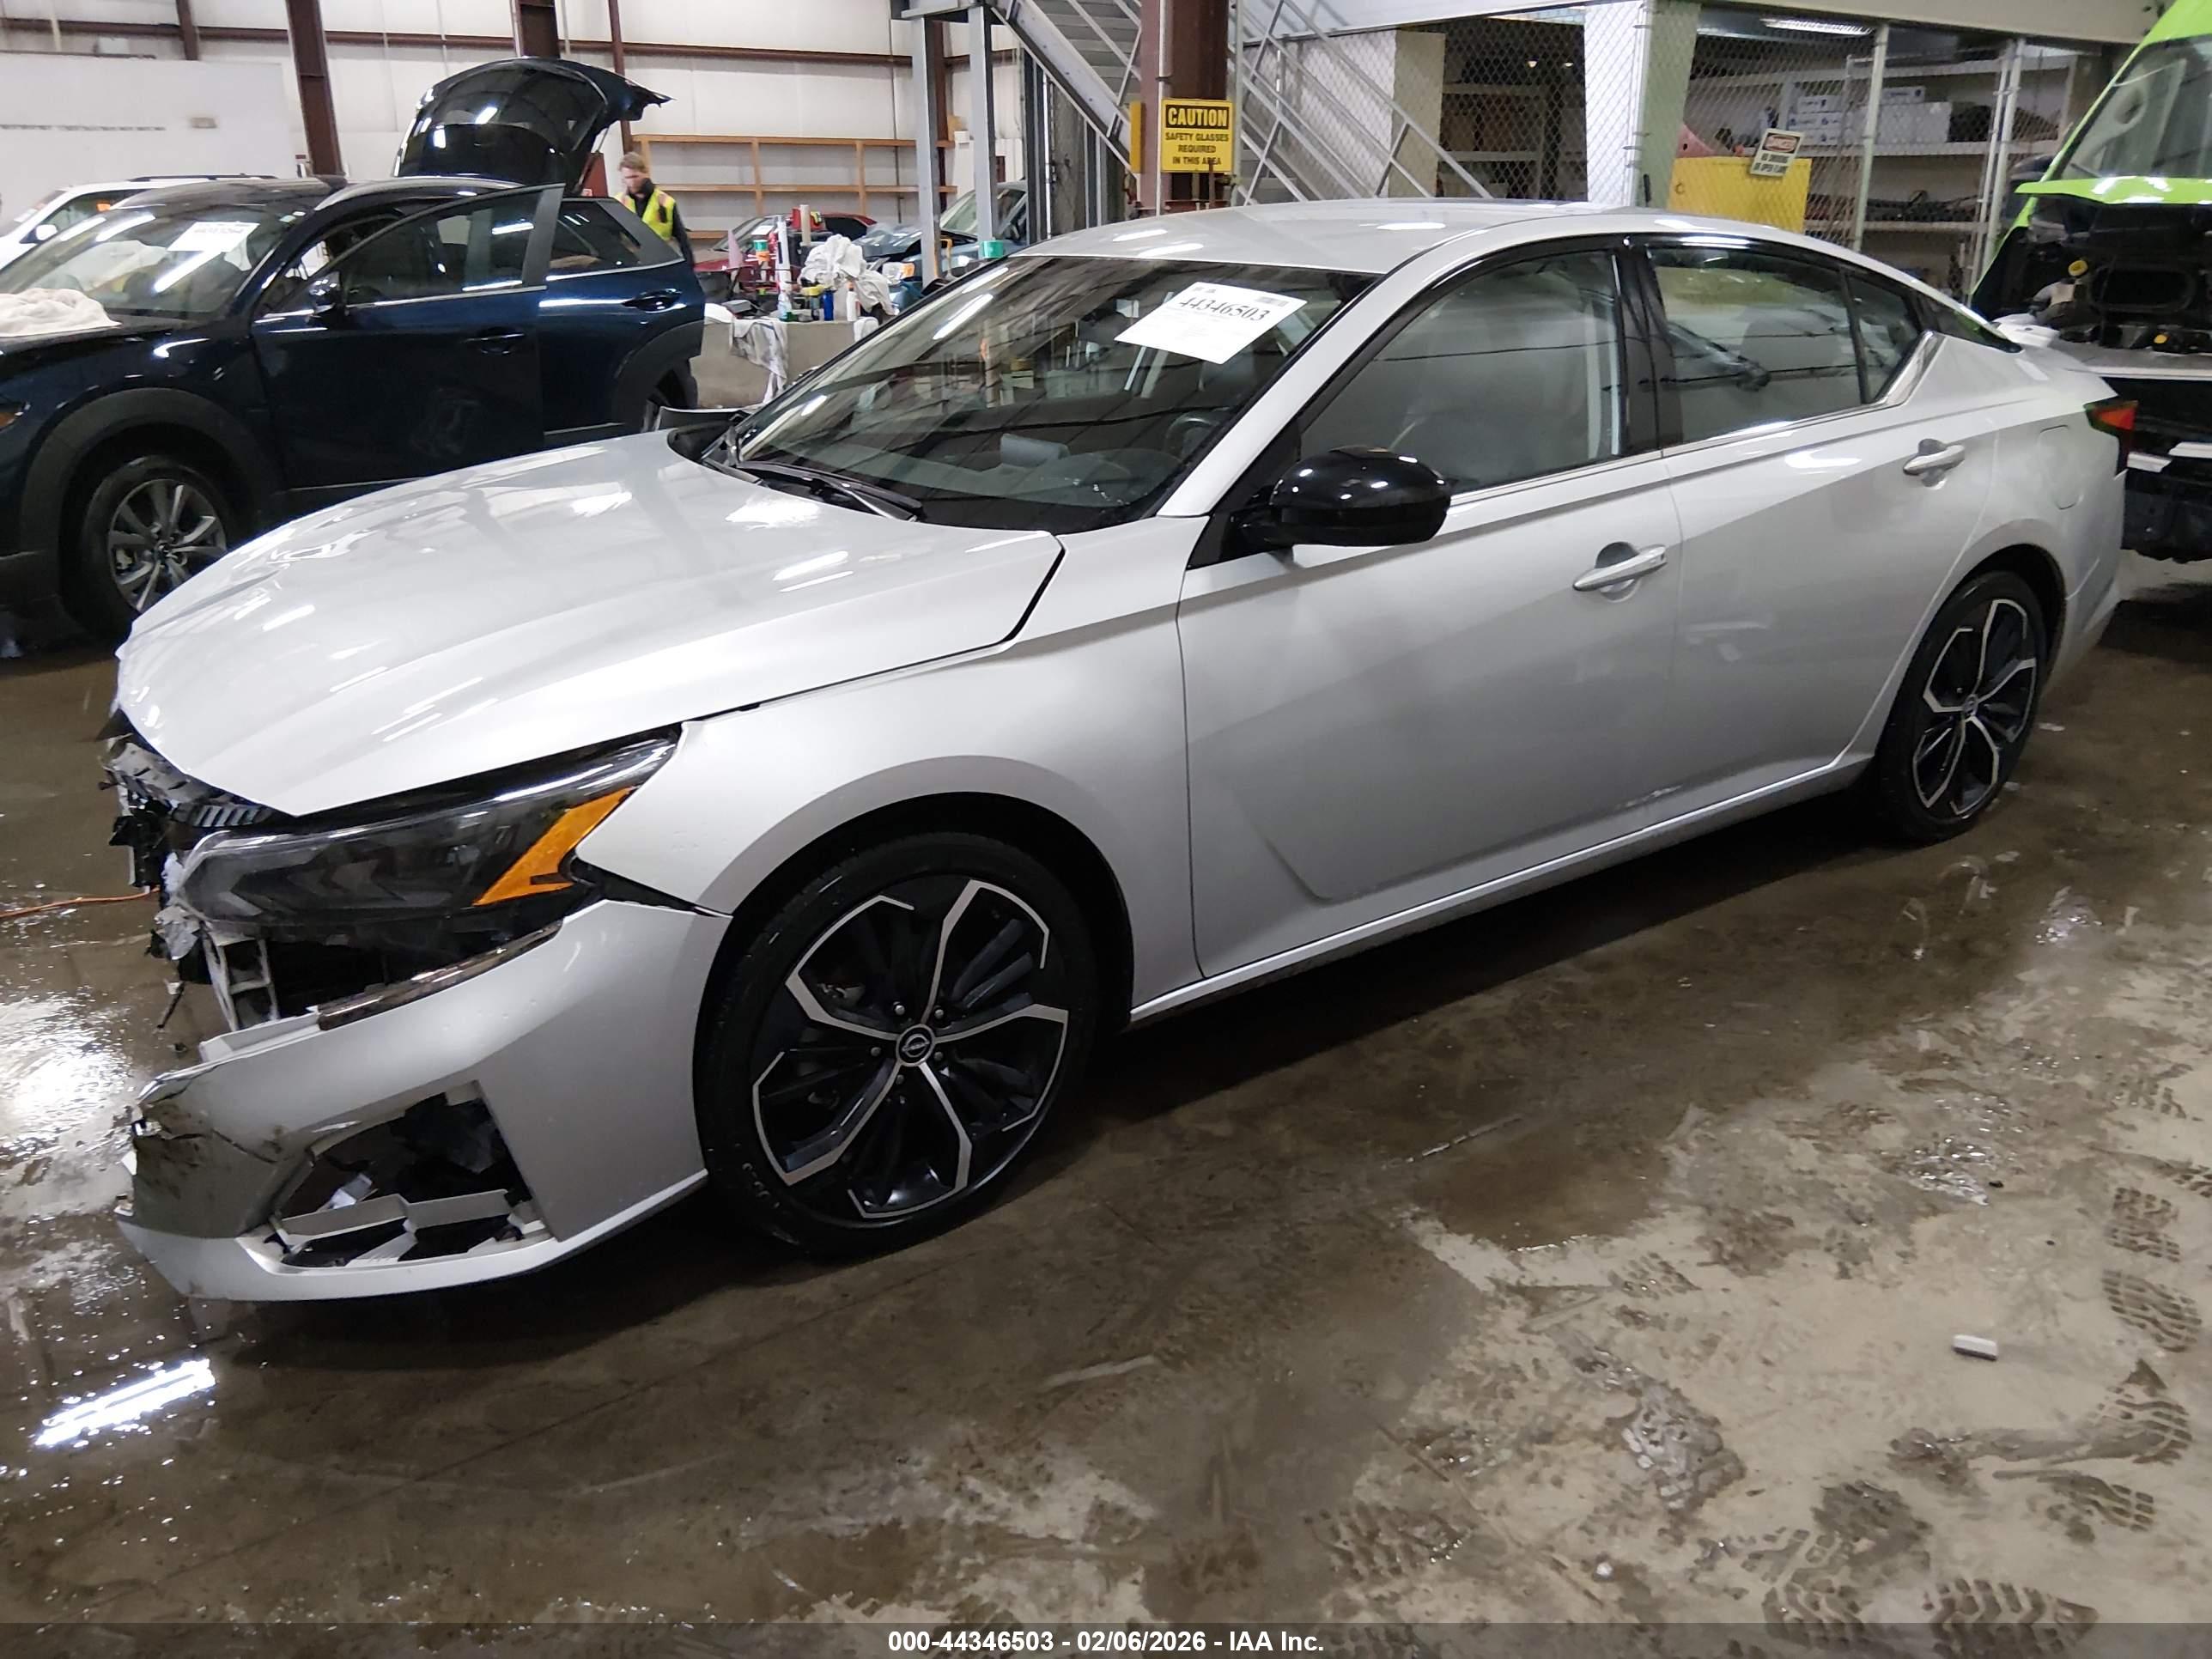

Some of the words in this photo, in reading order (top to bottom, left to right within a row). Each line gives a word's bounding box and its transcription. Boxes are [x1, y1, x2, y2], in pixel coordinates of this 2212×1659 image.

[1168, 107, 1227, 126] CAUTION
[1165, 132, 1194, 141] SAFETY
[1195, 133, 1229, 142] GLASSES
[1177, 144, 1216, 153] REQUIRED
[1183, 156, 1200, 165] THIS
[1178, 296, 1271, 321] 44346503
